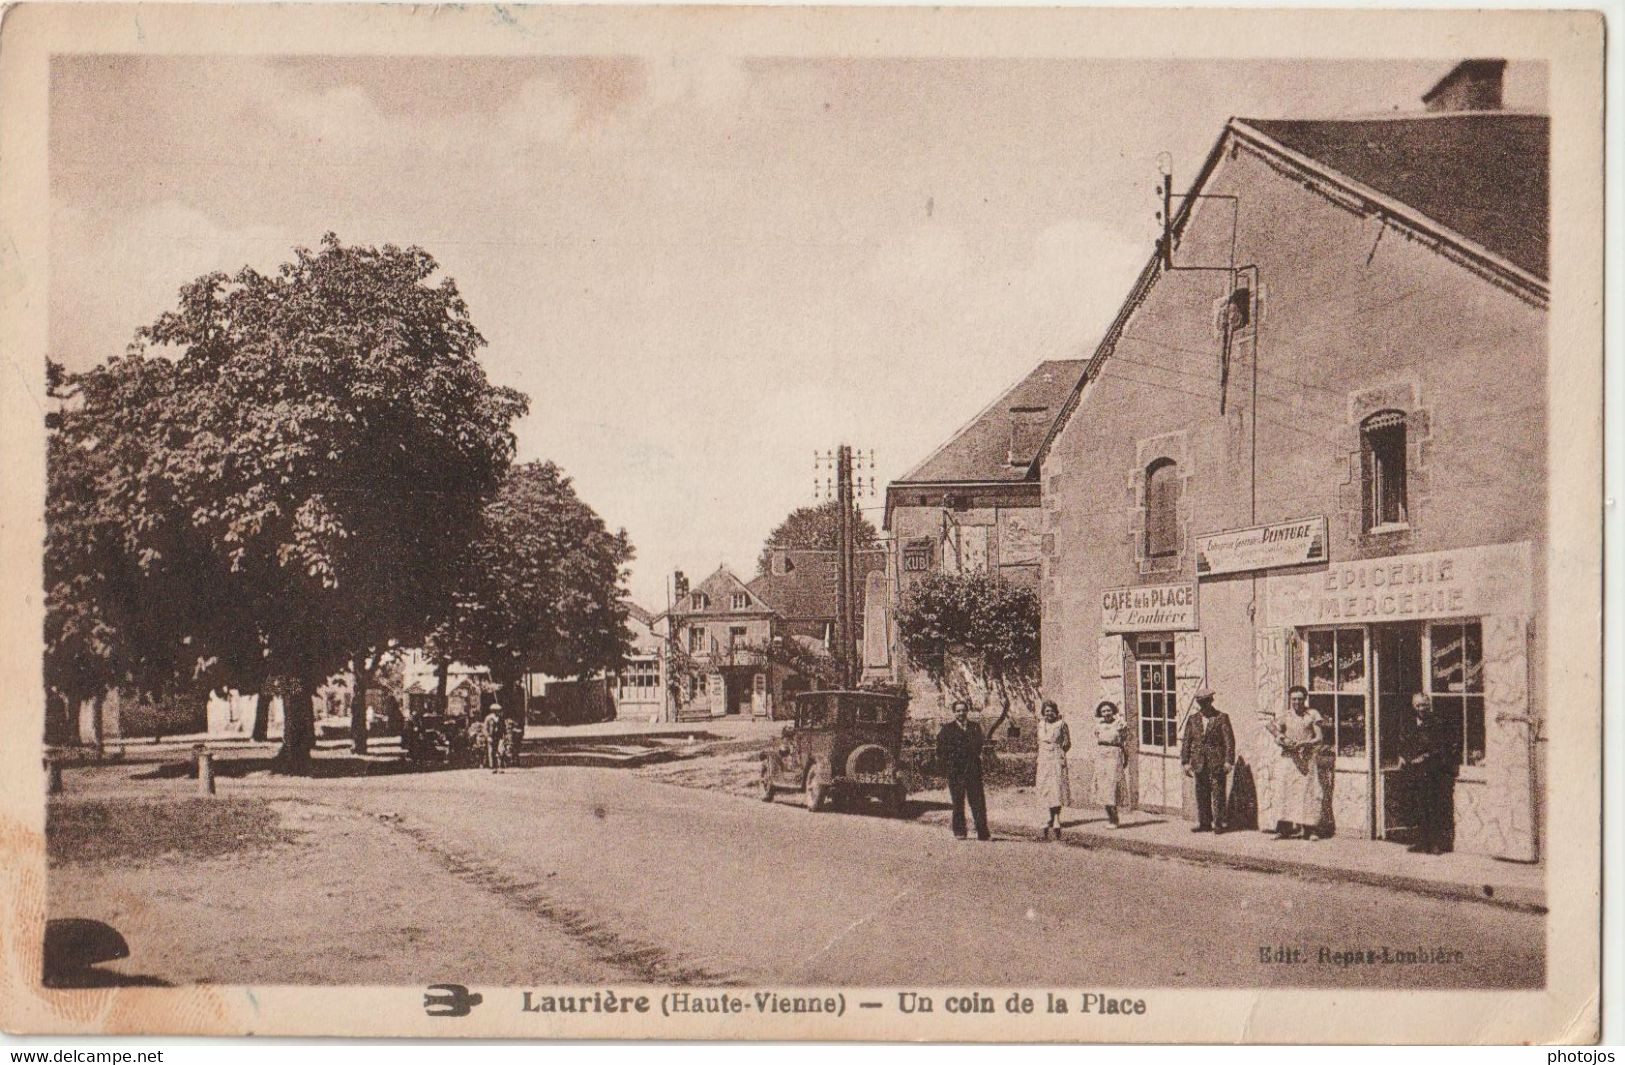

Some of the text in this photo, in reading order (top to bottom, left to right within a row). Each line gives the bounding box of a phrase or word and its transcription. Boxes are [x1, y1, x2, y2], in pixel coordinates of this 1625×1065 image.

[1262, 525, 1311, 543] PEINTURE
[905, 557, 926, 570] KUB
[1323, 558, 1456, 591] EPICERIE
[1103, 588, 1132, 610] CAFÉ
[1151, 587, 1193, 607] PLACE
[1317, 589, 1465, 619] MERCERIE
